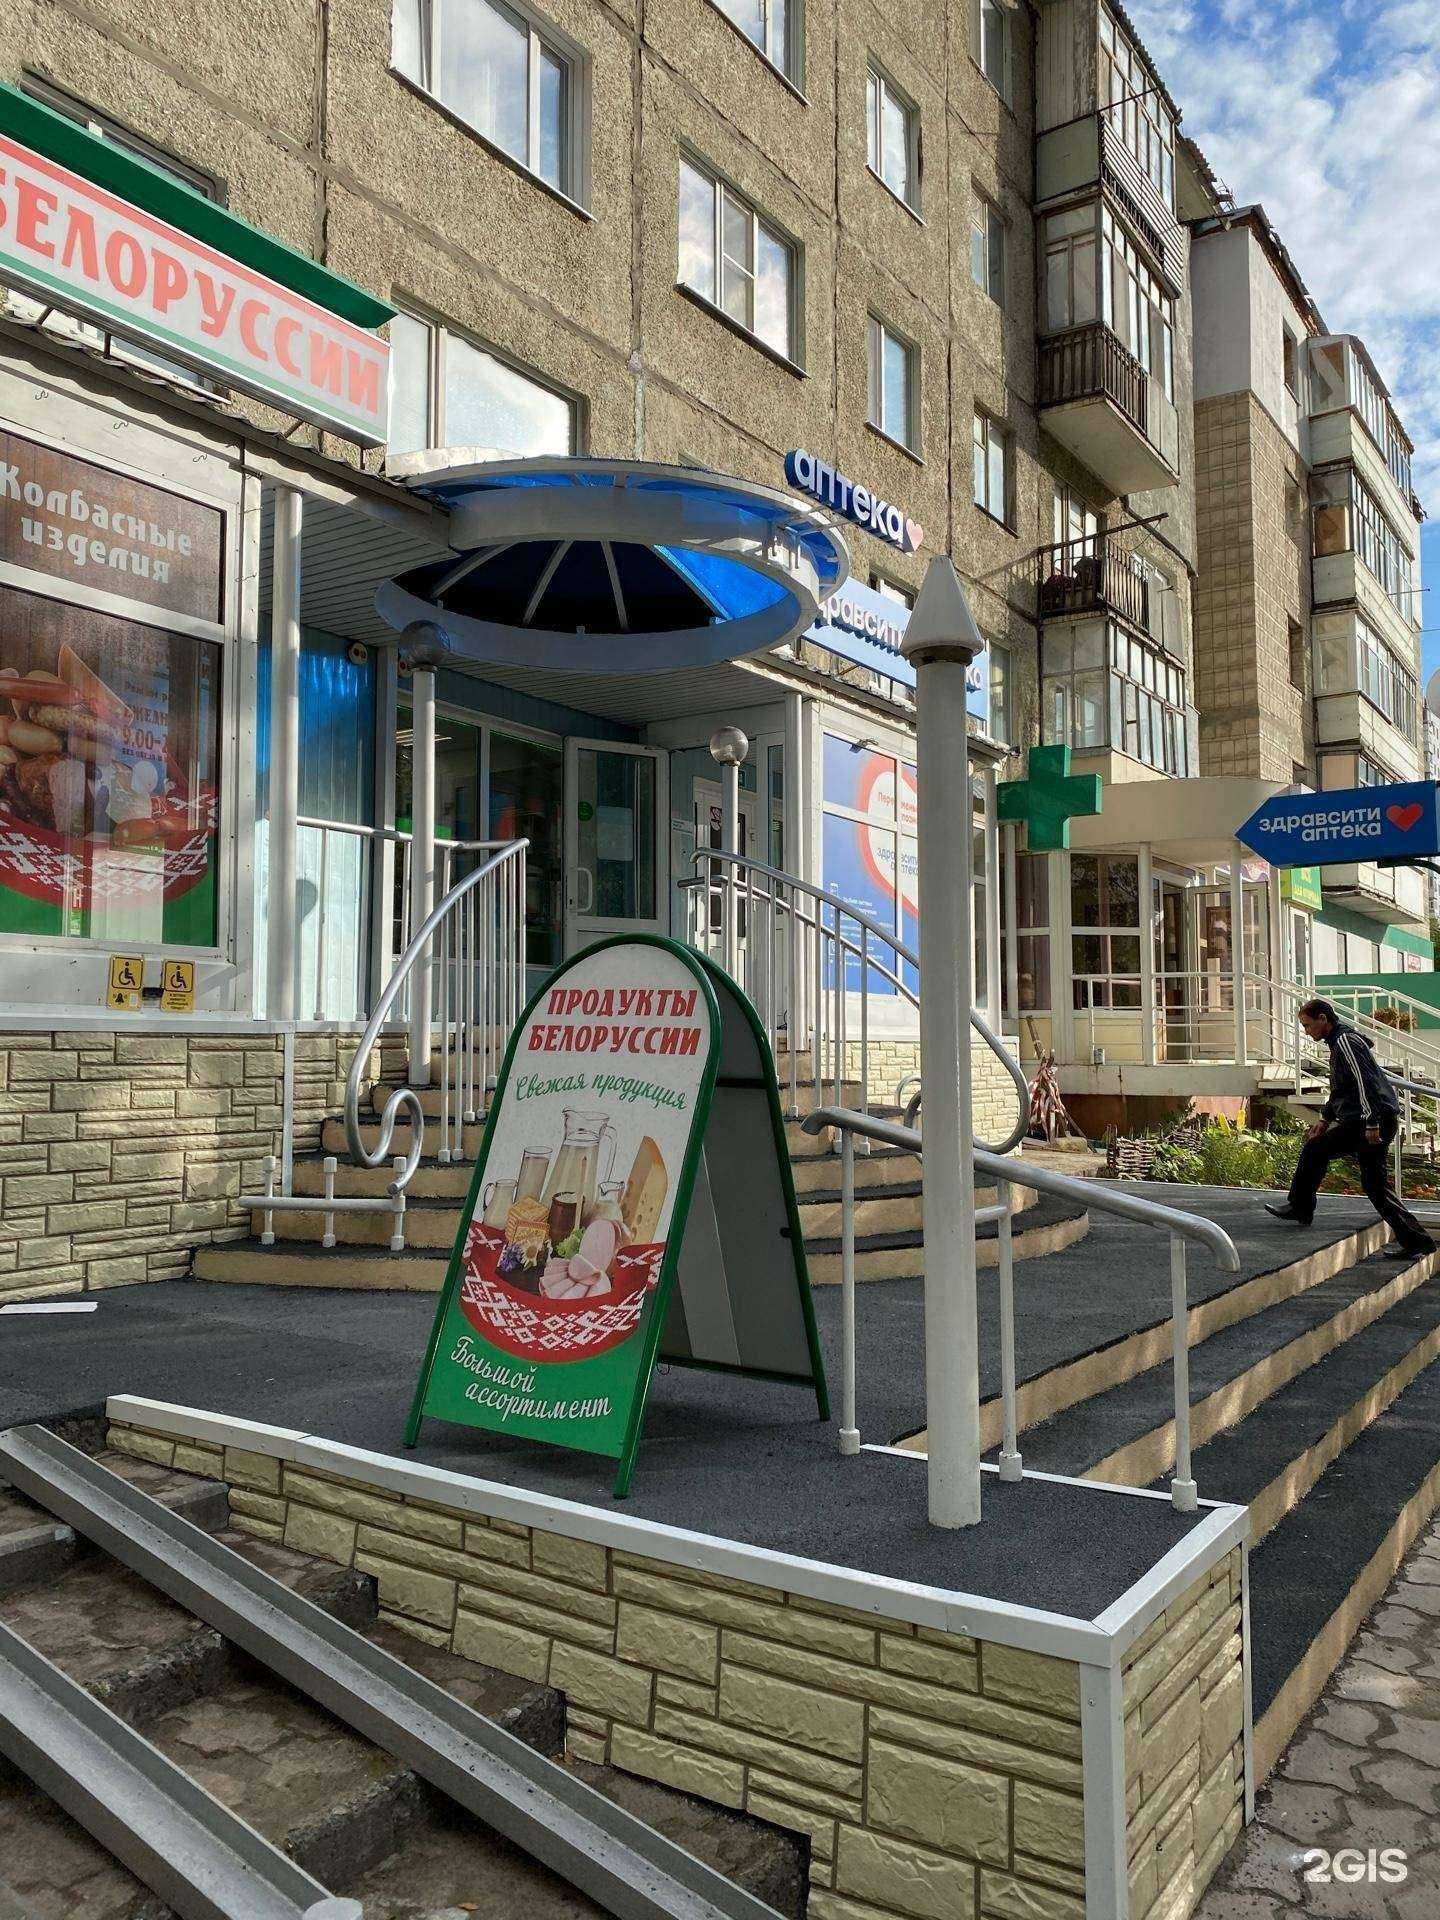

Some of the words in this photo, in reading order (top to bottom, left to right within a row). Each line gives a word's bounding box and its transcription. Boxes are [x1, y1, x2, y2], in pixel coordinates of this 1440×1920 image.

[0, 461, 192, 556] Колбасные
[786, 448, 904, 549] аптека
[21, 516, 170, 584] изделия
[1259, 807, 1381, 834] здравсити
[1302, 822, 1382, 842] аптека
[547, 989, 698, 1018] ПРОДУКТЫ
[527, 1025, 702, 1056] БЕЛОРУССИИ
[516, 1073, 586, 1101] Свежая
[591, 1074, 688, 1111] продукция
[451, 1335, 536, 1392] Большой
[465, 1381, 613, 1422] ассортимент
